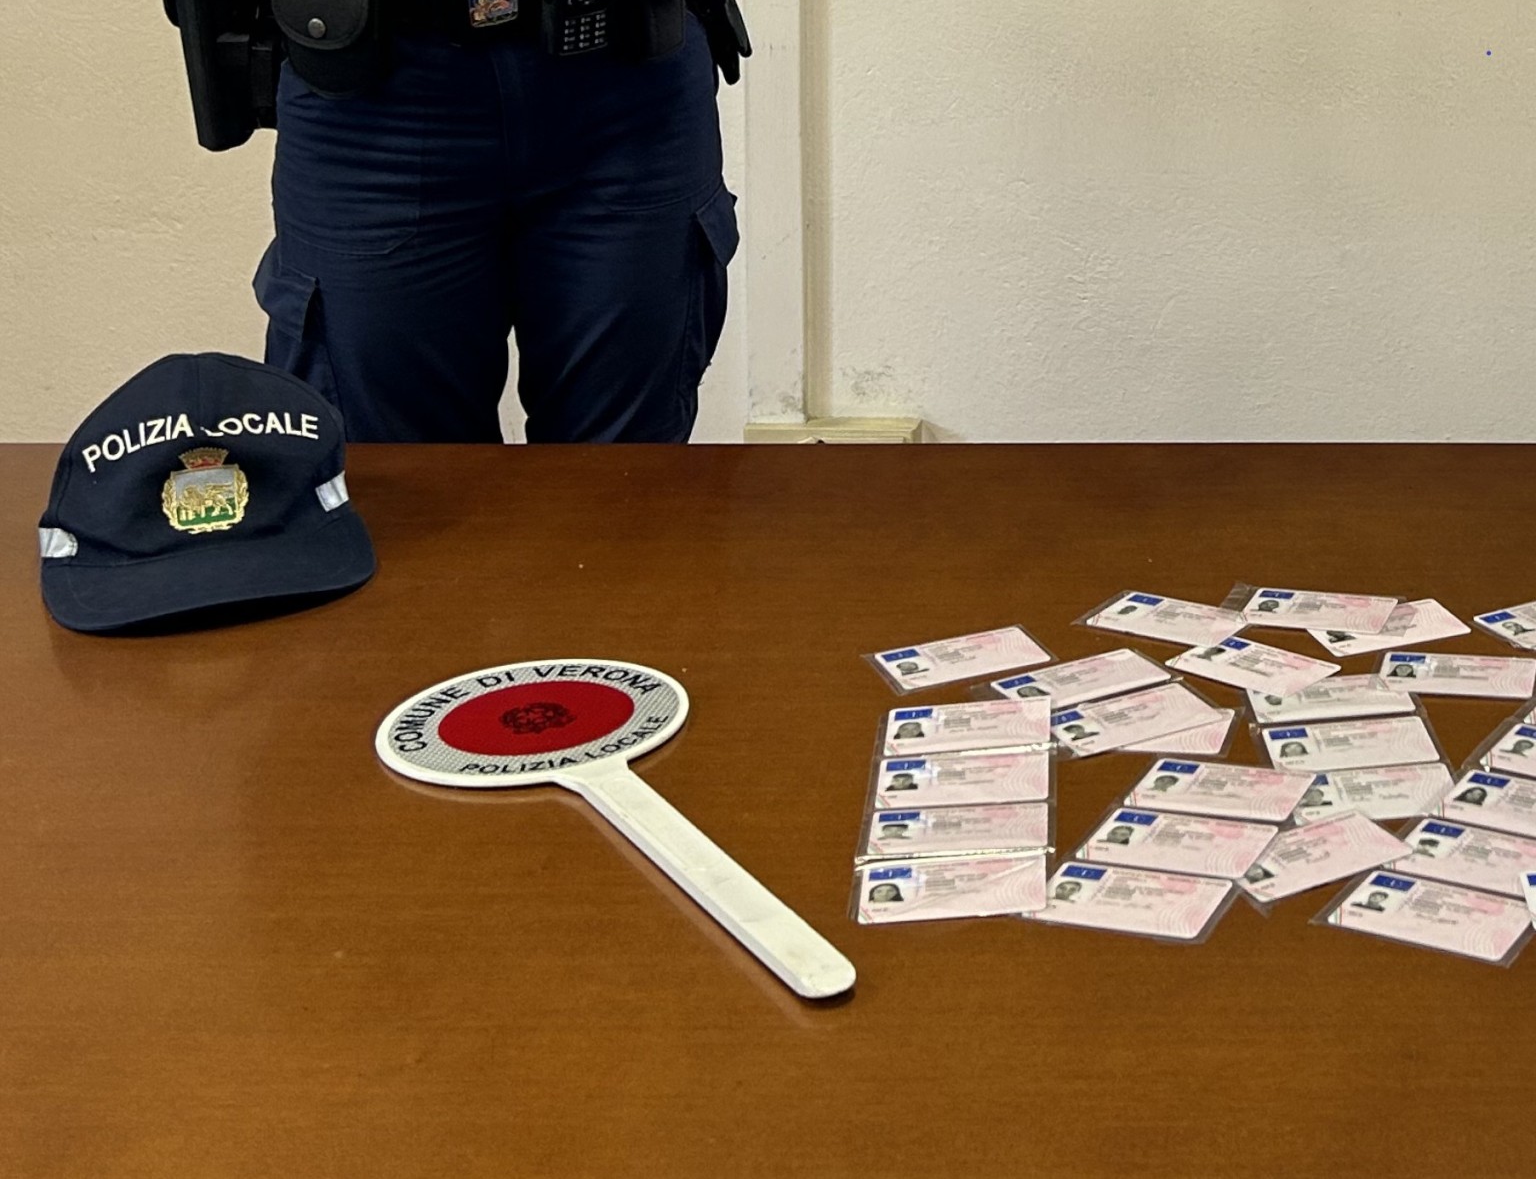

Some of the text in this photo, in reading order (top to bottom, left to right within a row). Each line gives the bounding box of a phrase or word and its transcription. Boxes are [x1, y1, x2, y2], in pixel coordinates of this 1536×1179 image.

[81, 413, 194, 473] POLIZIA
[393, 663, 662, 753] COMUNE DI VERONA
[459, 713, 670, 773] POLIZIA LOCALE
